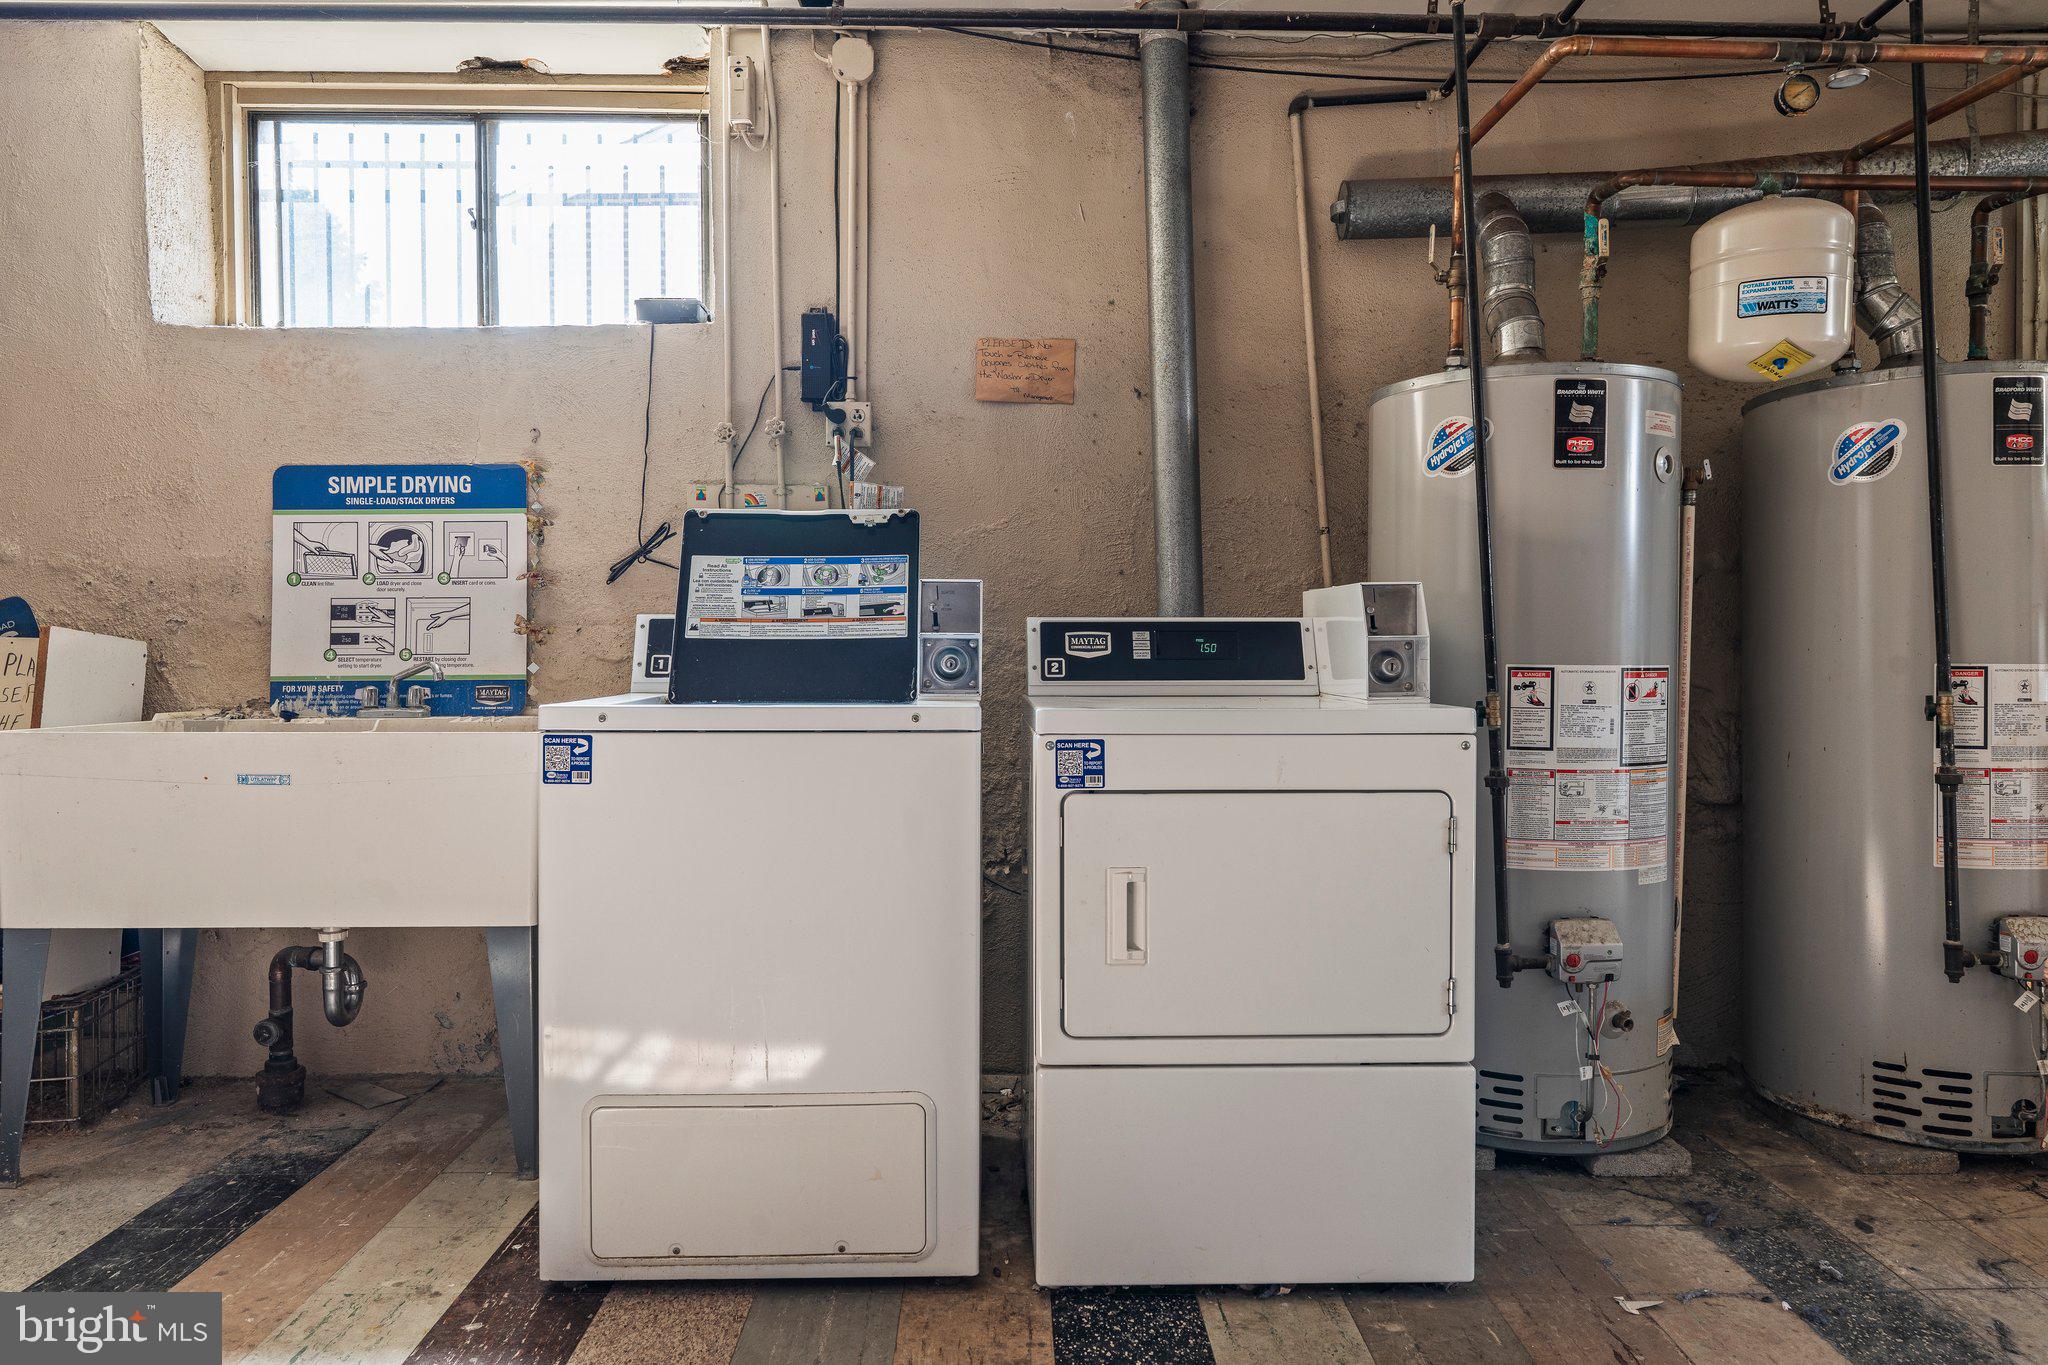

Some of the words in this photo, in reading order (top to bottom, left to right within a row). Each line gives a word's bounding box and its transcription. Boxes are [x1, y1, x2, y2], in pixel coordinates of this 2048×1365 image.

[1742, 286, 1777, 294] EXPANSION
[1743, 281, 1770, 289] POTABLE
[1757, 299, 1798, 310] WATTS
[978, 338, 1017, 348] PLEASE
[977, 349, 1004, 358] Touch
[1013, 350, 1048, 360] Remove
[1753, 361, 1783, 379] PROTECT
[1430, 434, 1466, 467] Hydrojet
[1837, 440, 1877, 476] Hydrojet
[328, 476, 396, 494] SIMPLE
[402, 476, 471, 494] DRYING
[345, 497, 424, 505] SINGLE-LOAD/STACK
[426, 497, 455, 505] DRYERS
[4, 652, 36, 677] PLA
[658, 659, 664, 669] 1
[1051, 662, 1059, 672] 2
